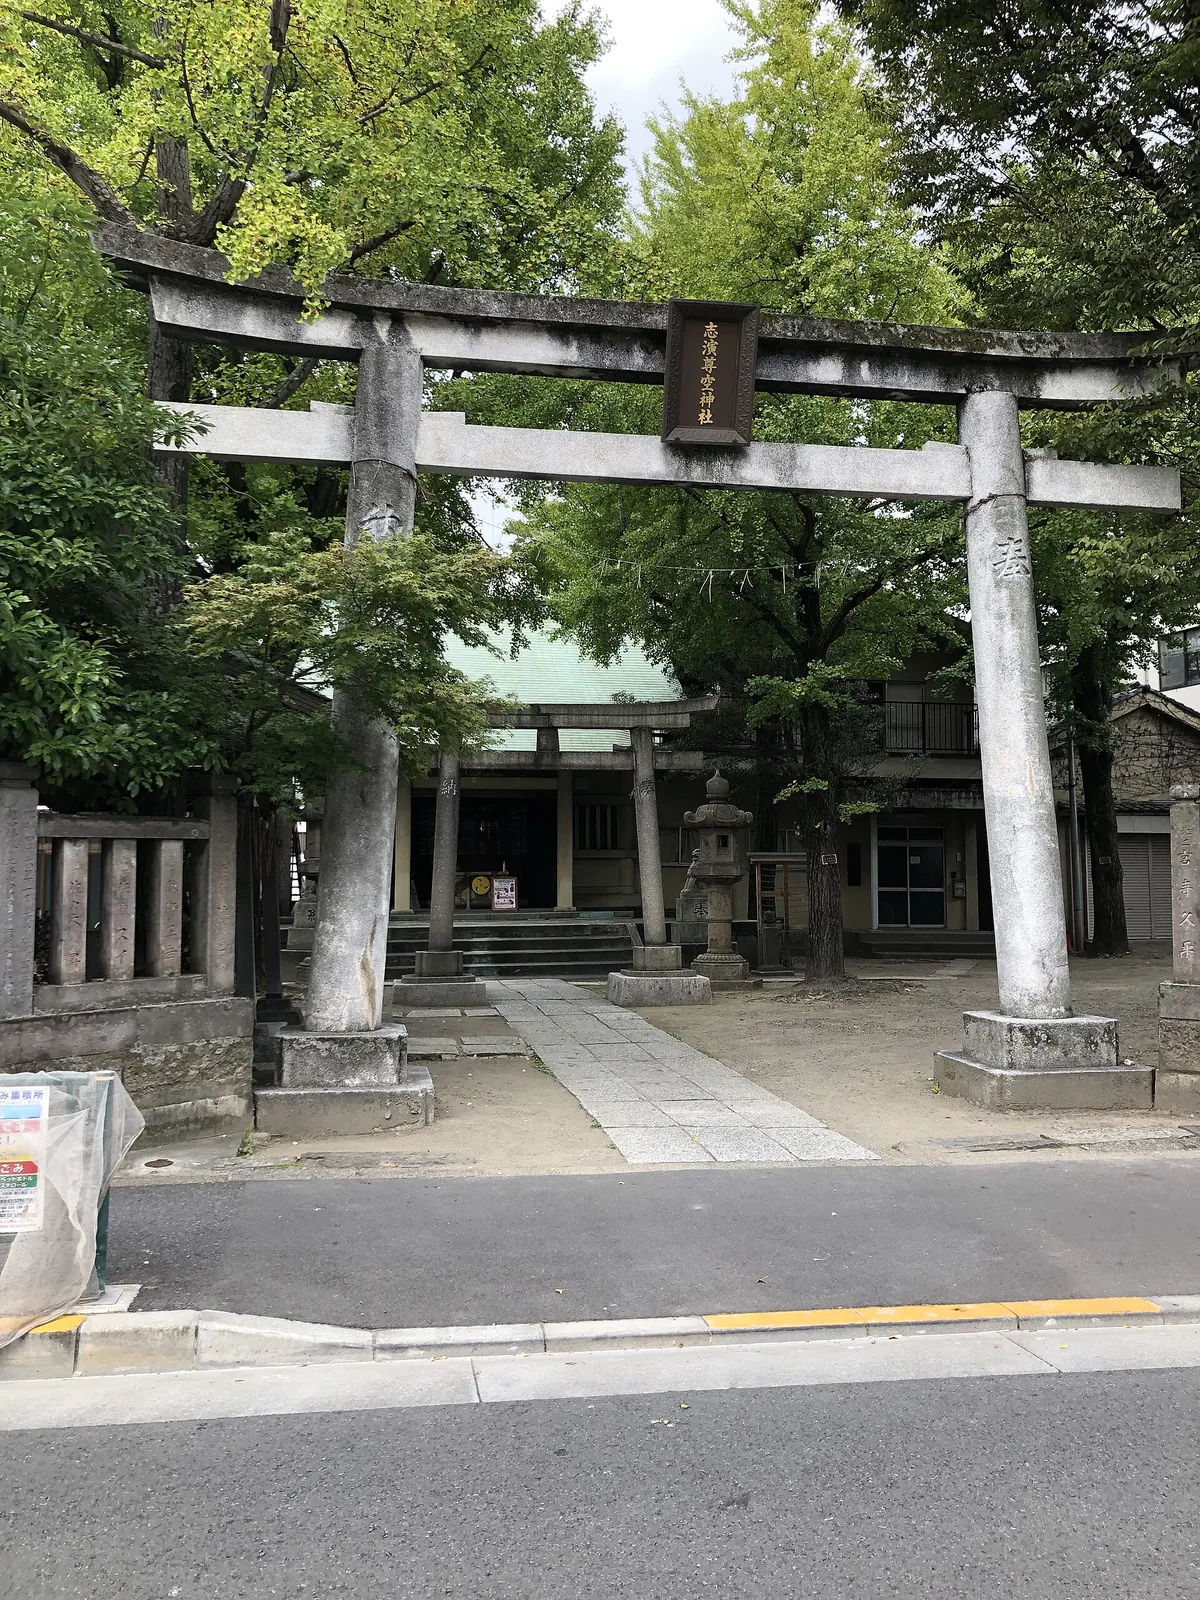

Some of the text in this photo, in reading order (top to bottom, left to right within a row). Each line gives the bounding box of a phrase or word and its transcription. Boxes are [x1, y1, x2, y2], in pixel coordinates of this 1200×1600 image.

[698, 321, 719, 425] 志演尊空神社
[992, 536, 1031, 578] 奉
[692, 900, 709, 918] 奉
